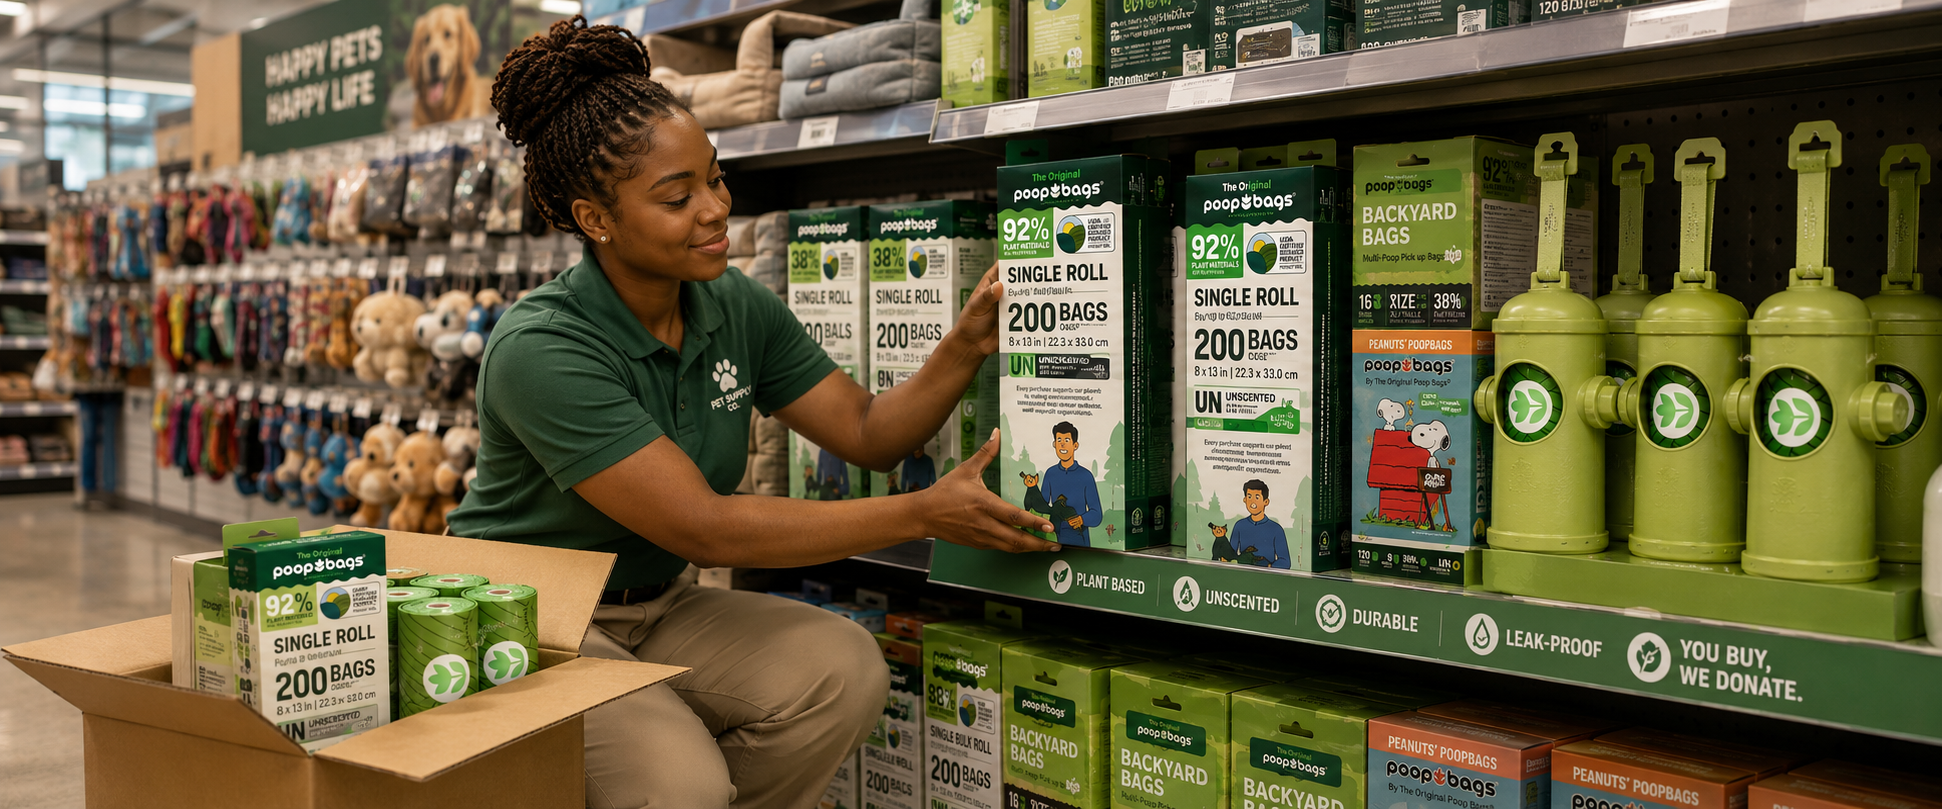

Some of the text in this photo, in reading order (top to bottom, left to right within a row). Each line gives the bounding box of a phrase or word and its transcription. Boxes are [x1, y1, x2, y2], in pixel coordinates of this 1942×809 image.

[265, 25, 383, 88] HAPPY PETS
[266, 69, 375, 126] HAPPY LIFE
[1032, 168, 1081, 182] The Original
[1222, 180, 1272, 193] The Original
[1362, 202, 1457, 224] BACKYARD
[1002, 216, 1050, 242] 92%
[1362, 226, 1410, 246] BAGS
[873, 246, 904, 268] 38%
[1192, 234, 1239, 260] 92%
[1008, 263, 1108, 284] SINGLE ROLL
[795, 290, 853, 304] SINGLE ROLL
[876, 288, 943, 304] SINGLE ROLL
[1194, 287, 1299, 307] SINGLE ROLL
[1359, 294, 1372, 310] 16
[1008, 302, 1108, 332] 200 BAGS
[876, 322, 942, 348] 200 BAGS
[1008, 336, 1014, 346] 8
[1034, 336, 1042, 346] in
[1194, 328, 1298, 361] 200 BAGS
[1408, 338, 1452, 350] POOPBAGS
[1010, 356, 1034, 376] UN
[1194, 366, 1200, 376] 8
[1208, 366, 1218, 377] 13
[1220, 366, 1228, 378] in
[1236, 368, 1254, 378] 22.3
[1256, 370, 1260, 378] x
[1284, 372, 1298, 380] cm
[1366, 378, 1373, 386] By
[710, 384, 752, 410] PET SUPPLY
[728, 402, 741, 412] CO.
[1195, 390, 1222, 414] UN
[1076, 572, 1146, 594] PLANT BASED
[266, 592, 314, 617] 92%
[1205, 589, 1280, 614] UNSCENTED
[1352, 608, 1419, 632] DURABLE
[274, 624, 376, 654] SINGLE ROLL
[1505, 628, 1603, 659] LEAK-PROOF
[1679, 638, 1771, 673] YOU BUY,
[276, 666, 328, 702] 200
[330, 658, 376, 683] BAGS
[1679, 664, 1804, 704] WE DONATE.
[276, 706, 284, 716] 8
[292, 704, 302, 713] 13
[364, 691, 376, 700] cm
[930, 725, 954, 744] SINGLE
[974, 738, 992, 755] ROLL
[1010, 724, 1078, 759] BACKYARD
[1388, 735, 1498, 770] PEANUTS' POOPBAGS
[1010, 745, 1044, 770] BAGS
[1120, 748, 1208, 786] BACKYARD
[866, 770, 889, 794] 200
[931, 754, 960, 788] 200
[962, 764, 991, 789] BAGS
[1121, 770, 1165, 796] BAGS
[1244, 777, 1344, 809] BACKYARD
[1388, 782, 1398, 794] By
[1400, 784, 1413, 796] The
[1448, 794, 1468, 809] Poop
[1572, 766, 1699, 806] PEANUTS' POOPBAGS
